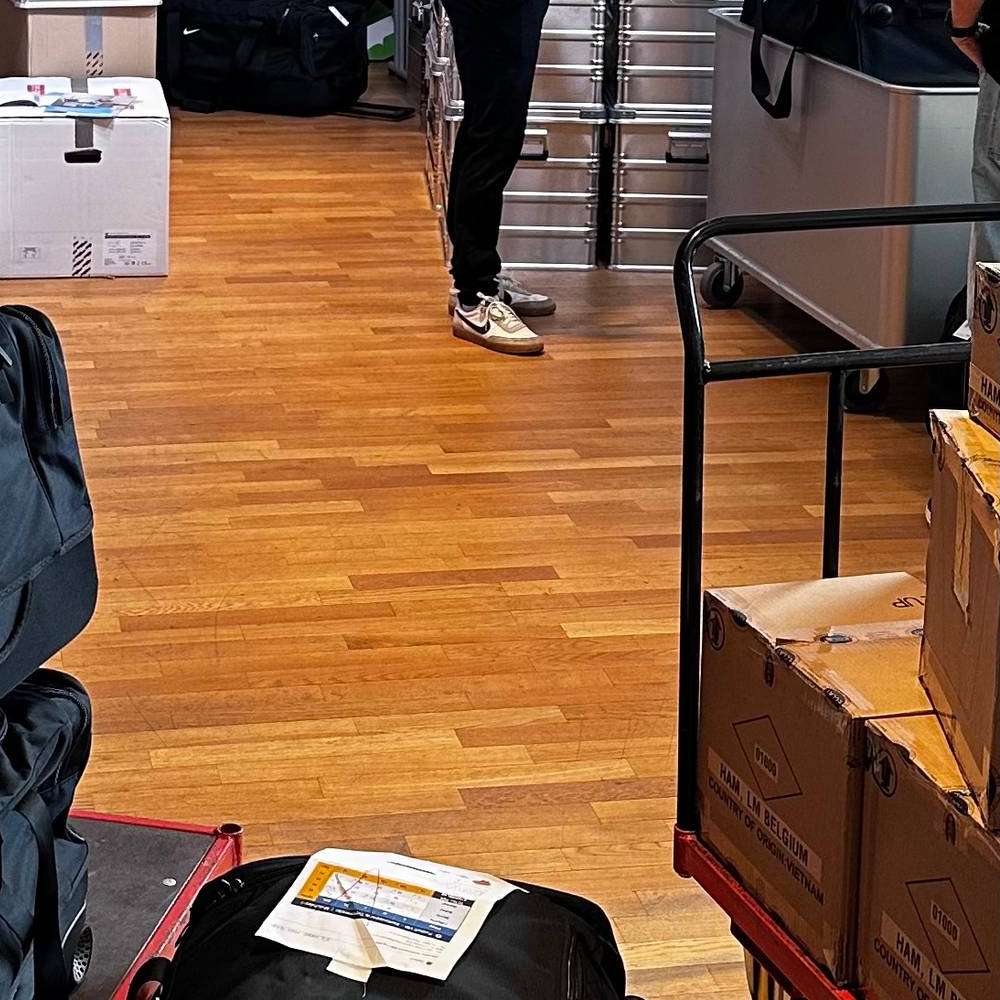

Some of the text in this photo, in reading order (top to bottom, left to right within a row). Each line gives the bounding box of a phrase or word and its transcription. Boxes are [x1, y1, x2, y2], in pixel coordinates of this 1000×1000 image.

[708, 775, 743, 822] COUNTRY
[744, 814, 756, 833] OF
[746, 789, 761, 818] LM
[763, 811, 809, 867] BELGIUM
[931, 903, 958, 942] 01000
[873, 937, 916, 992] COUNTRY
[929, 967, 946, 1000] LM
